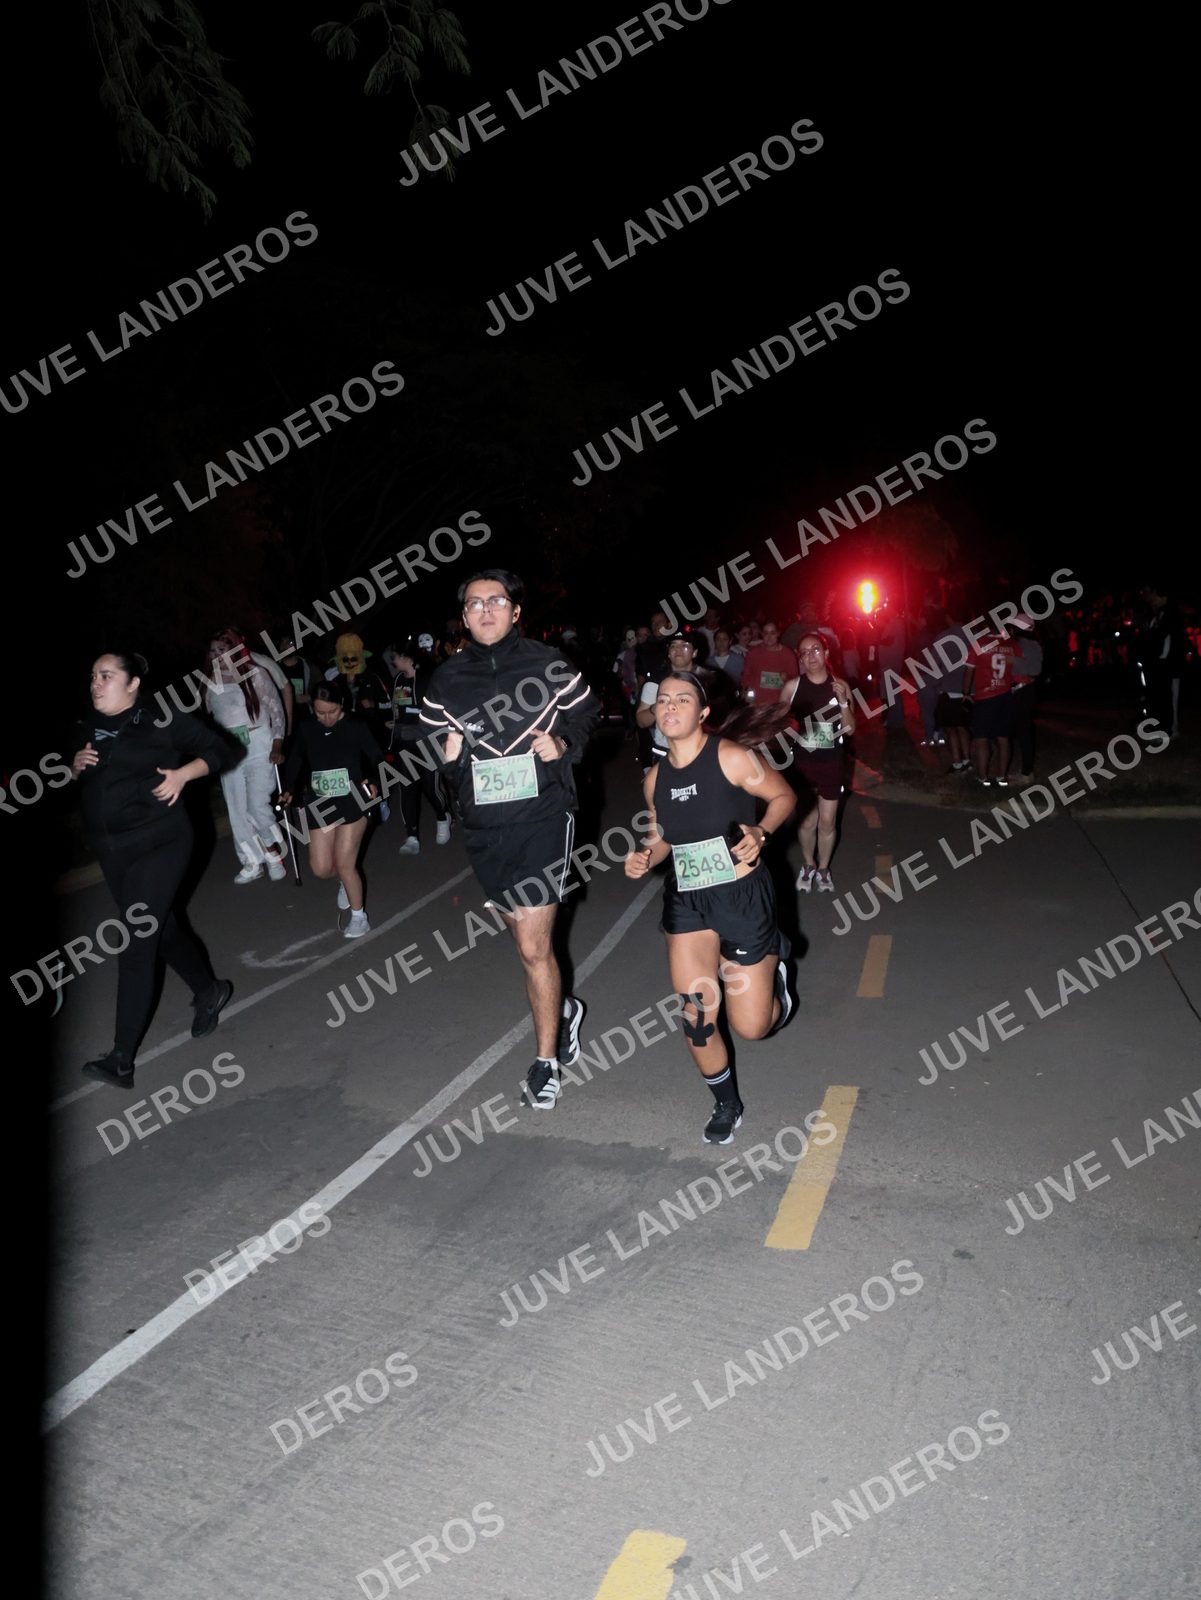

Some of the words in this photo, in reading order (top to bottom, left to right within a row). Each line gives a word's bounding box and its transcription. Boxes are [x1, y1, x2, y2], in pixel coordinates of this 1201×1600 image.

[315, 777, 346, 791] 1828
[480, 769, 529, 792] 2547
[679, 853, 726, 878] 2548
